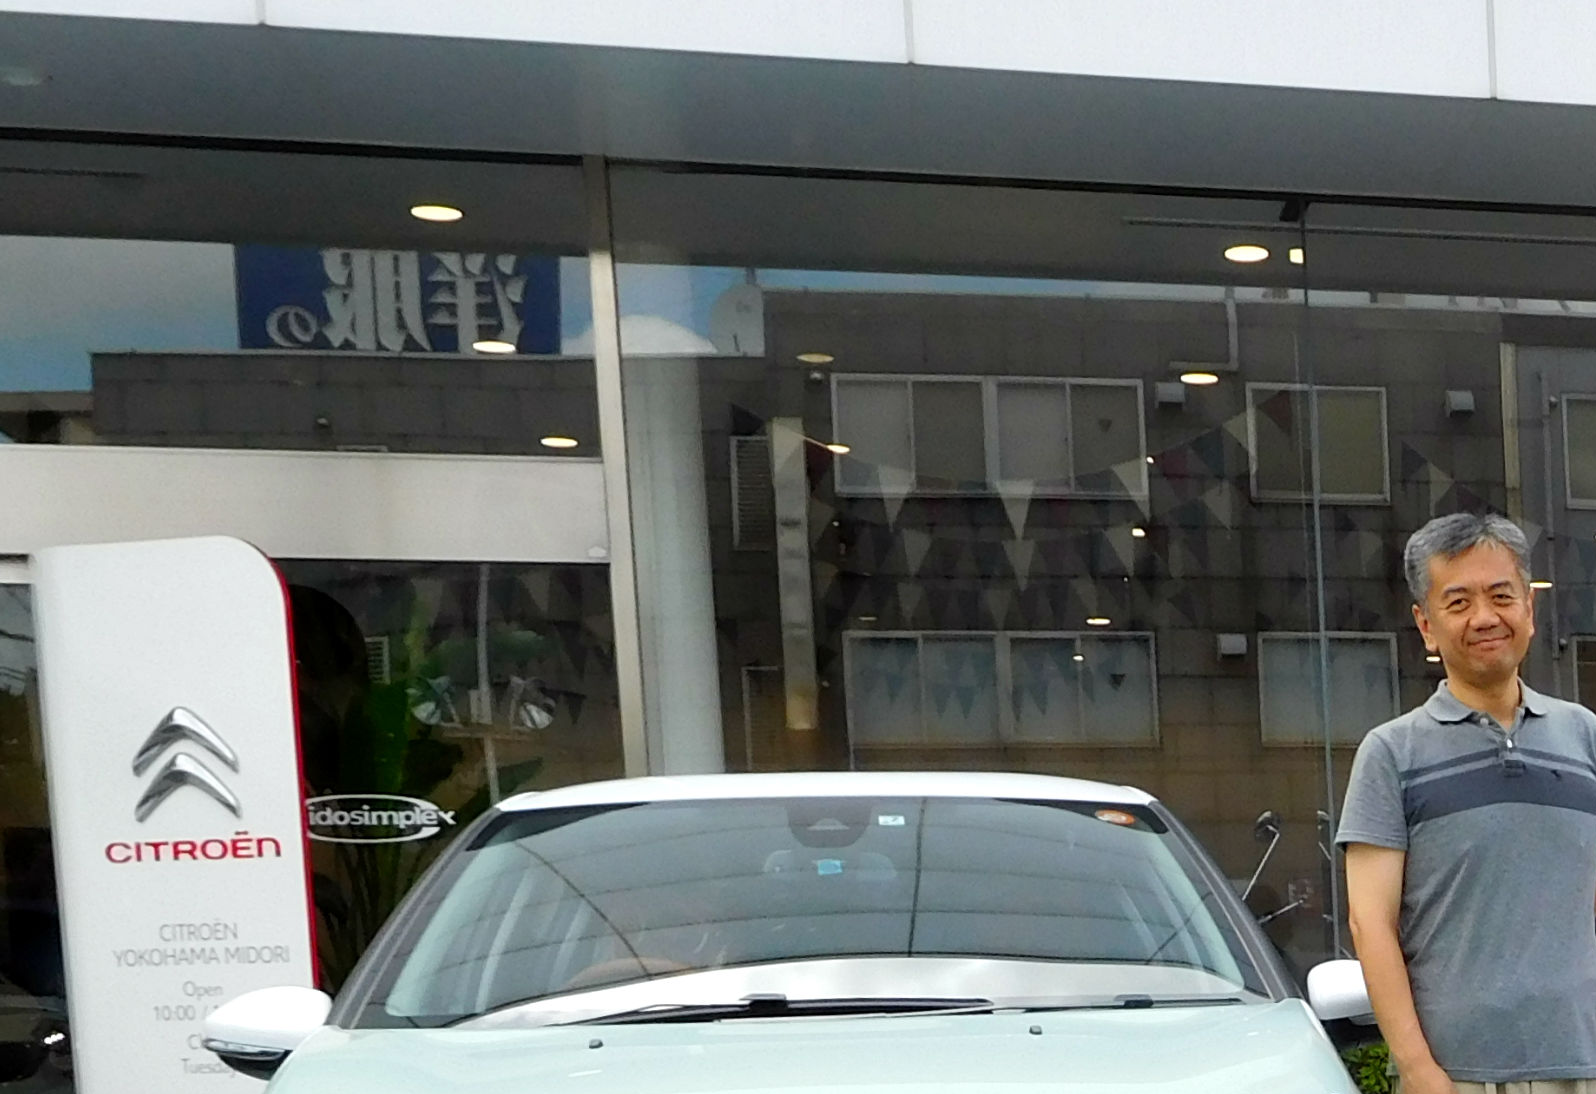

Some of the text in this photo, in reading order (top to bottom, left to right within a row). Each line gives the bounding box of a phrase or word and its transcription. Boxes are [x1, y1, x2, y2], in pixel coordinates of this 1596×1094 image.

[159, 918, 238, 942] CITROËN
[113, 945, 290, 967] YOKOHAMA MIDORI
[182, 980, 223, 1001] Open
[153, 1004, 196, 1021] 10:00
